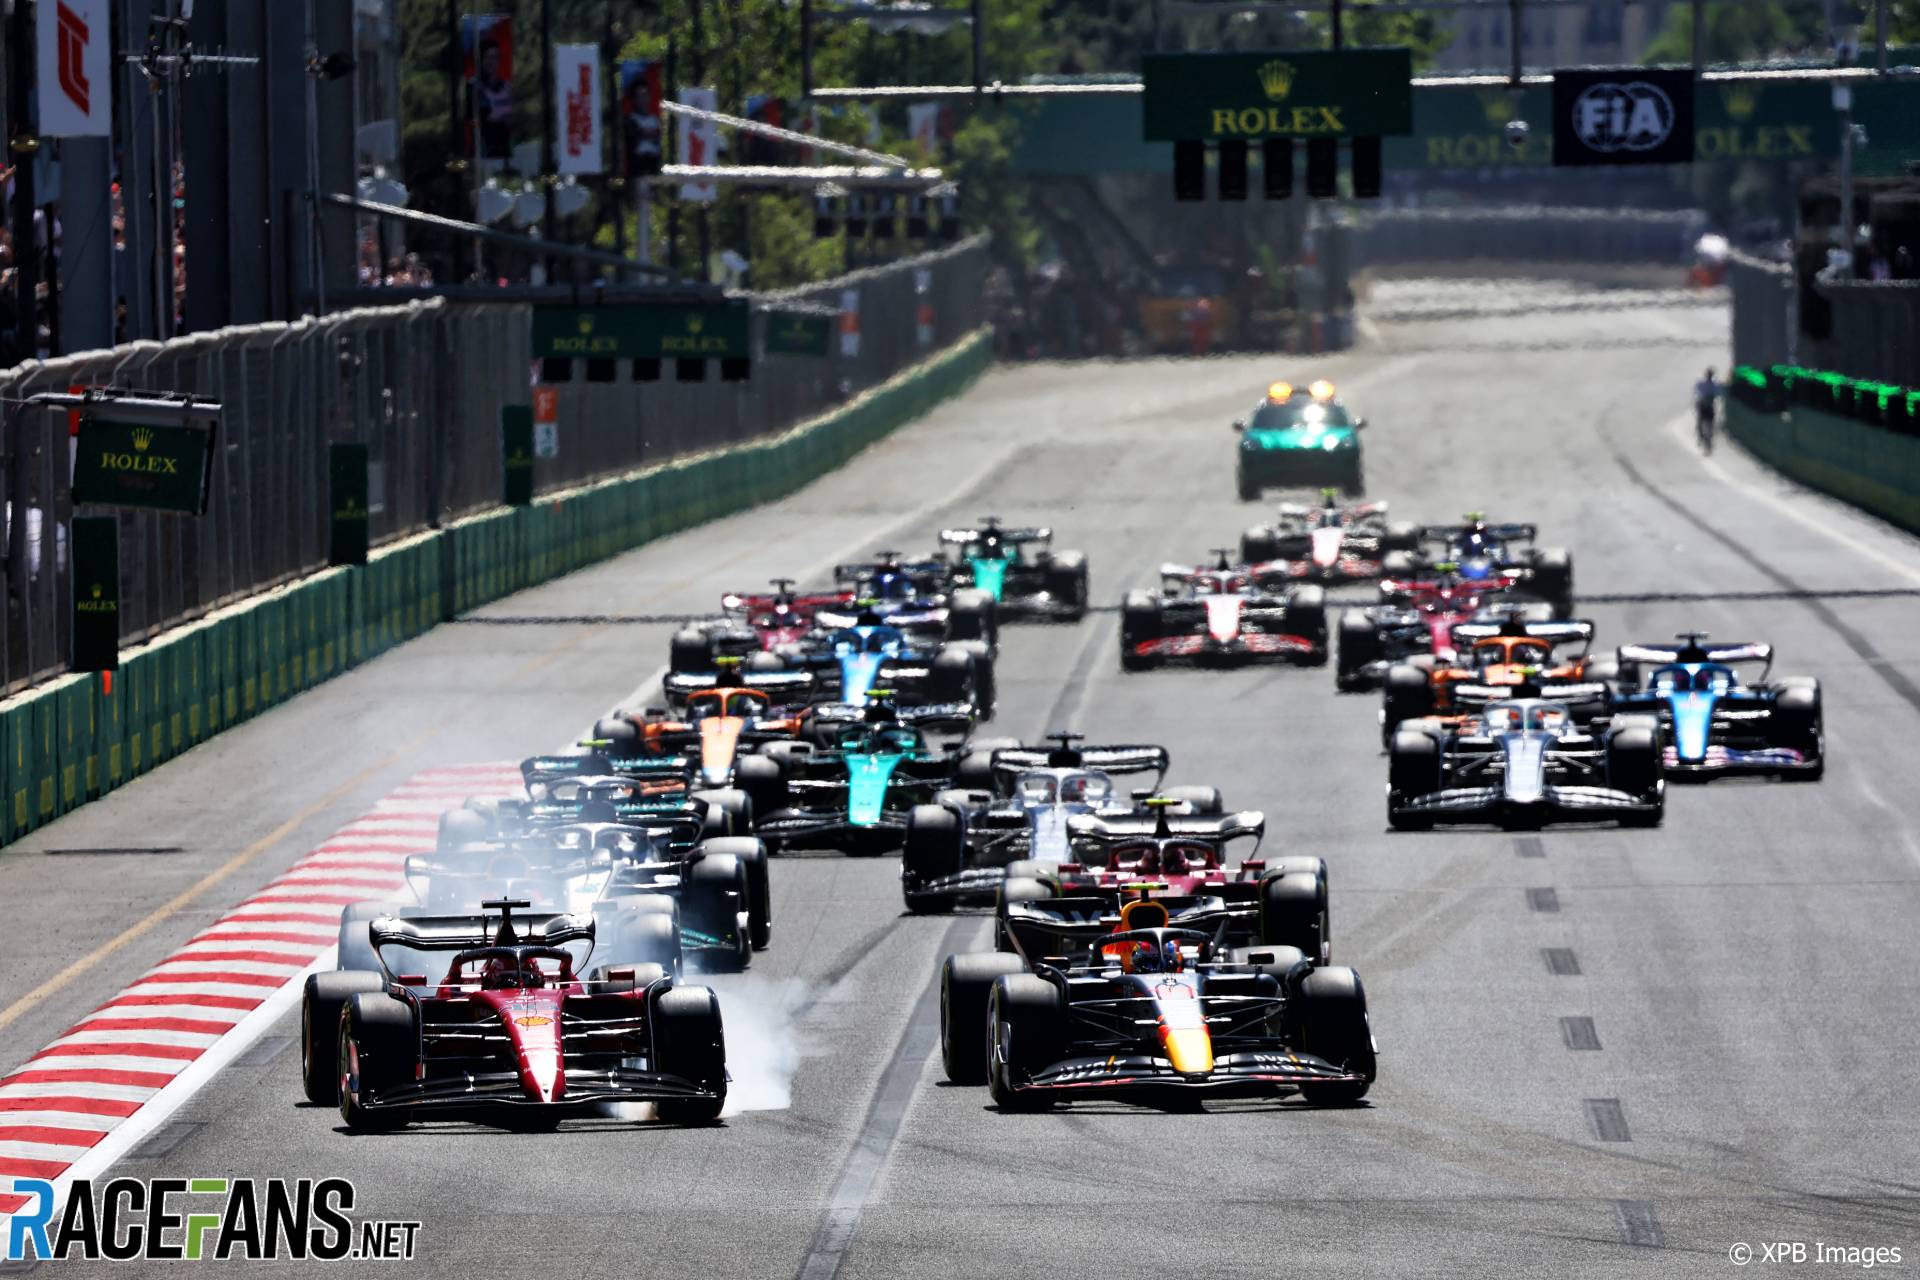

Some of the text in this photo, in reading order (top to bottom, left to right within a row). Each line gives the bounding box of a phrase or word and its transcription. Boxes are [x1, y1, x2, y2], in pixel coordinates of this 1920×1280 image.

[1211, 106, 1345, 135] ROLEX
[1694, 125, 1813, 160] OLEX
[100, 451, 178, 474] ROLEX
